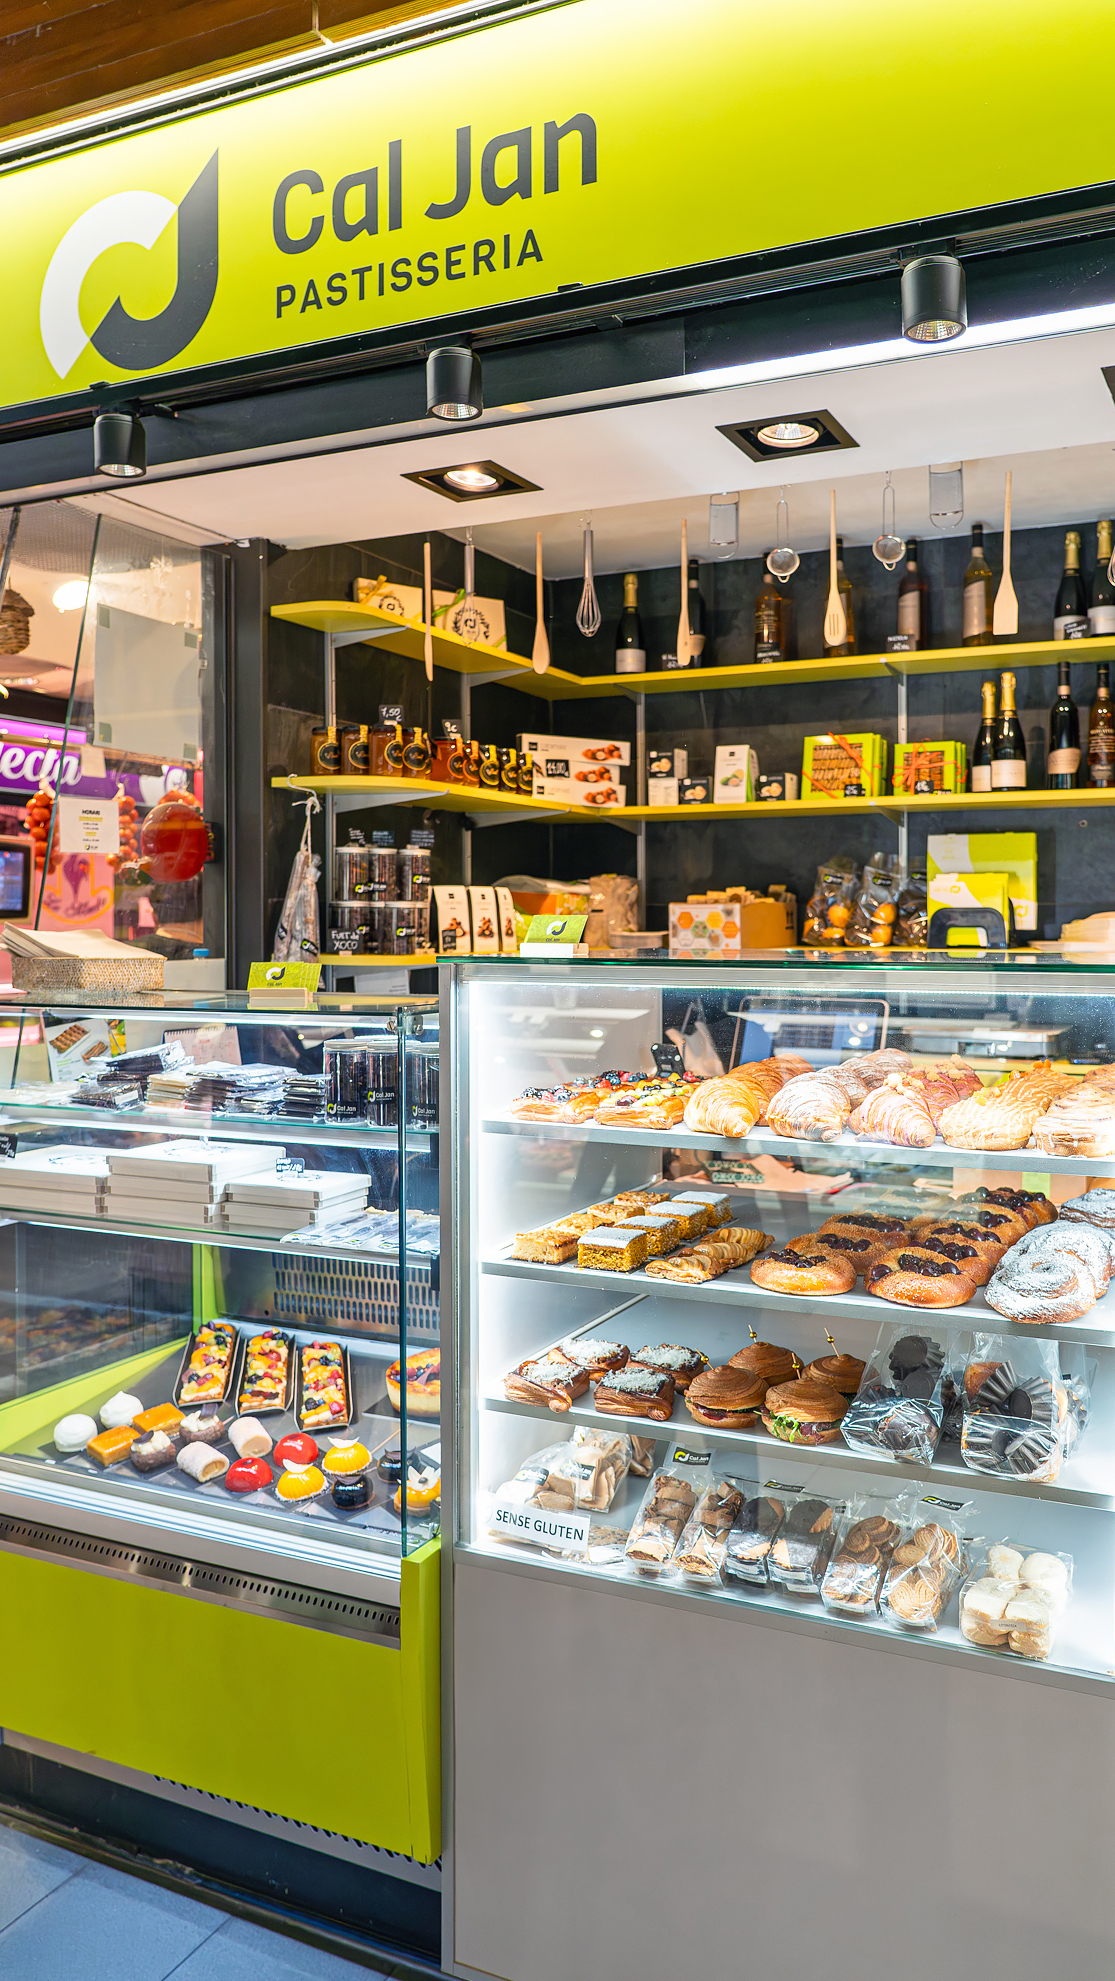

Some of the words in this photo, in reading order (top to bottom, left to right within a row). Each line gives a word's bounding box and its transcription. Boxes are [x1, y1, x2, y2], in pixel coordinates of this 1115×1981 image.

[272, 139, 403, 254] Cal
[424, 113, 598, 220] Jan
[275, 229, 543, 319] PASTISSERIA
[495, 1509, 531, 1529] SENSE
[533, 1519, 584, 1540] GLUTEN
